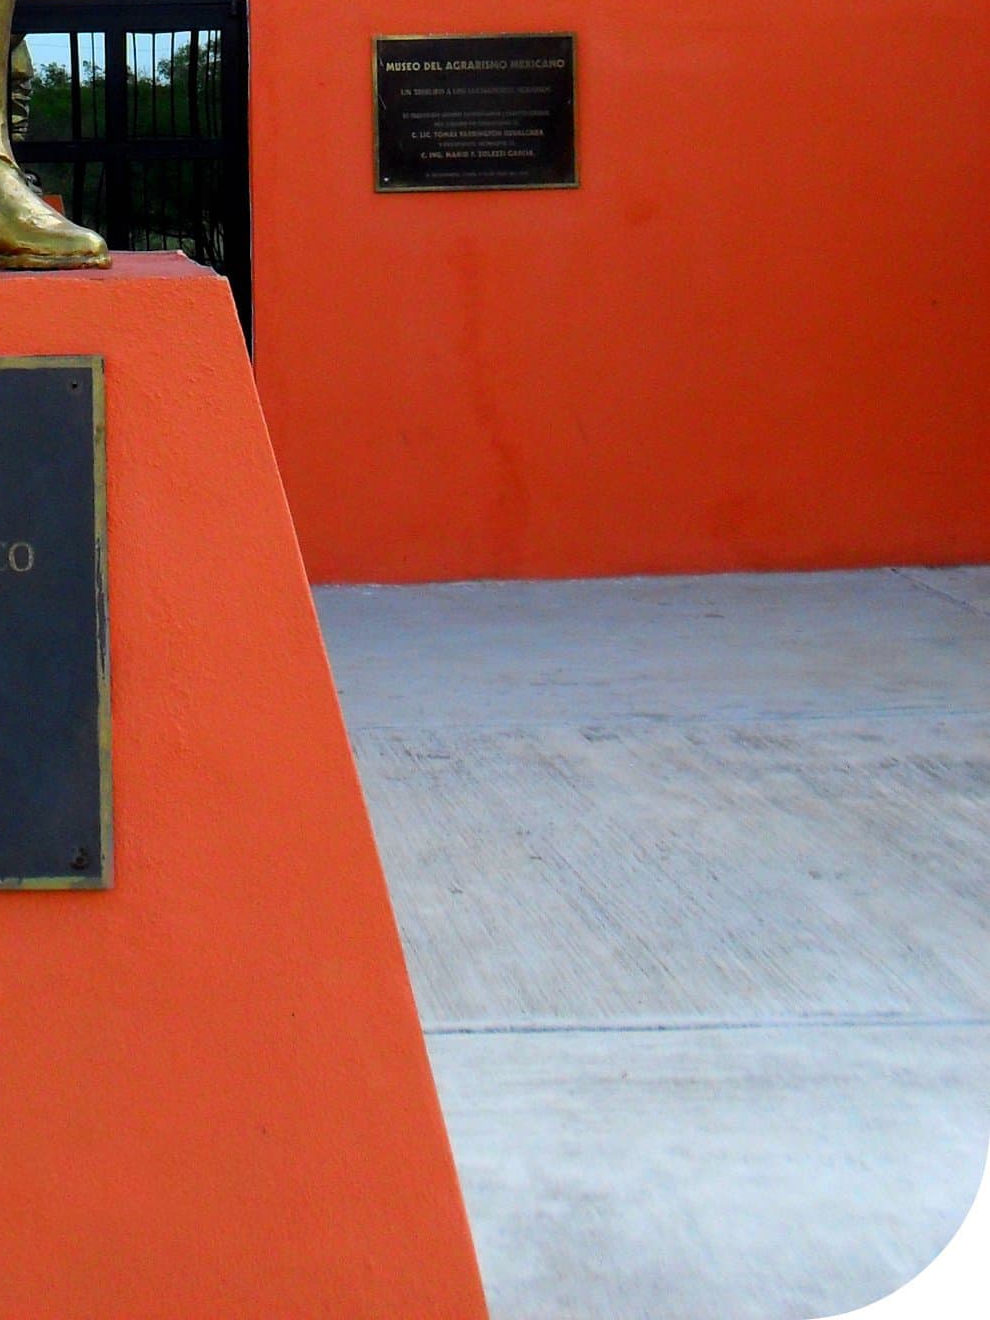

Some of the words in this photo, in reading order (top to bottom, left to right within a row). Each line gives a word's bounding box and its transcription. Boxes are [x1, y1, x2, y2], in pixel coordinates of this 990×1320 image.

[386, 61, 421, 72] MUSEO
[423, 61, 442, 71] DEL
[445, 59, 508, 71] AGRARISMO
